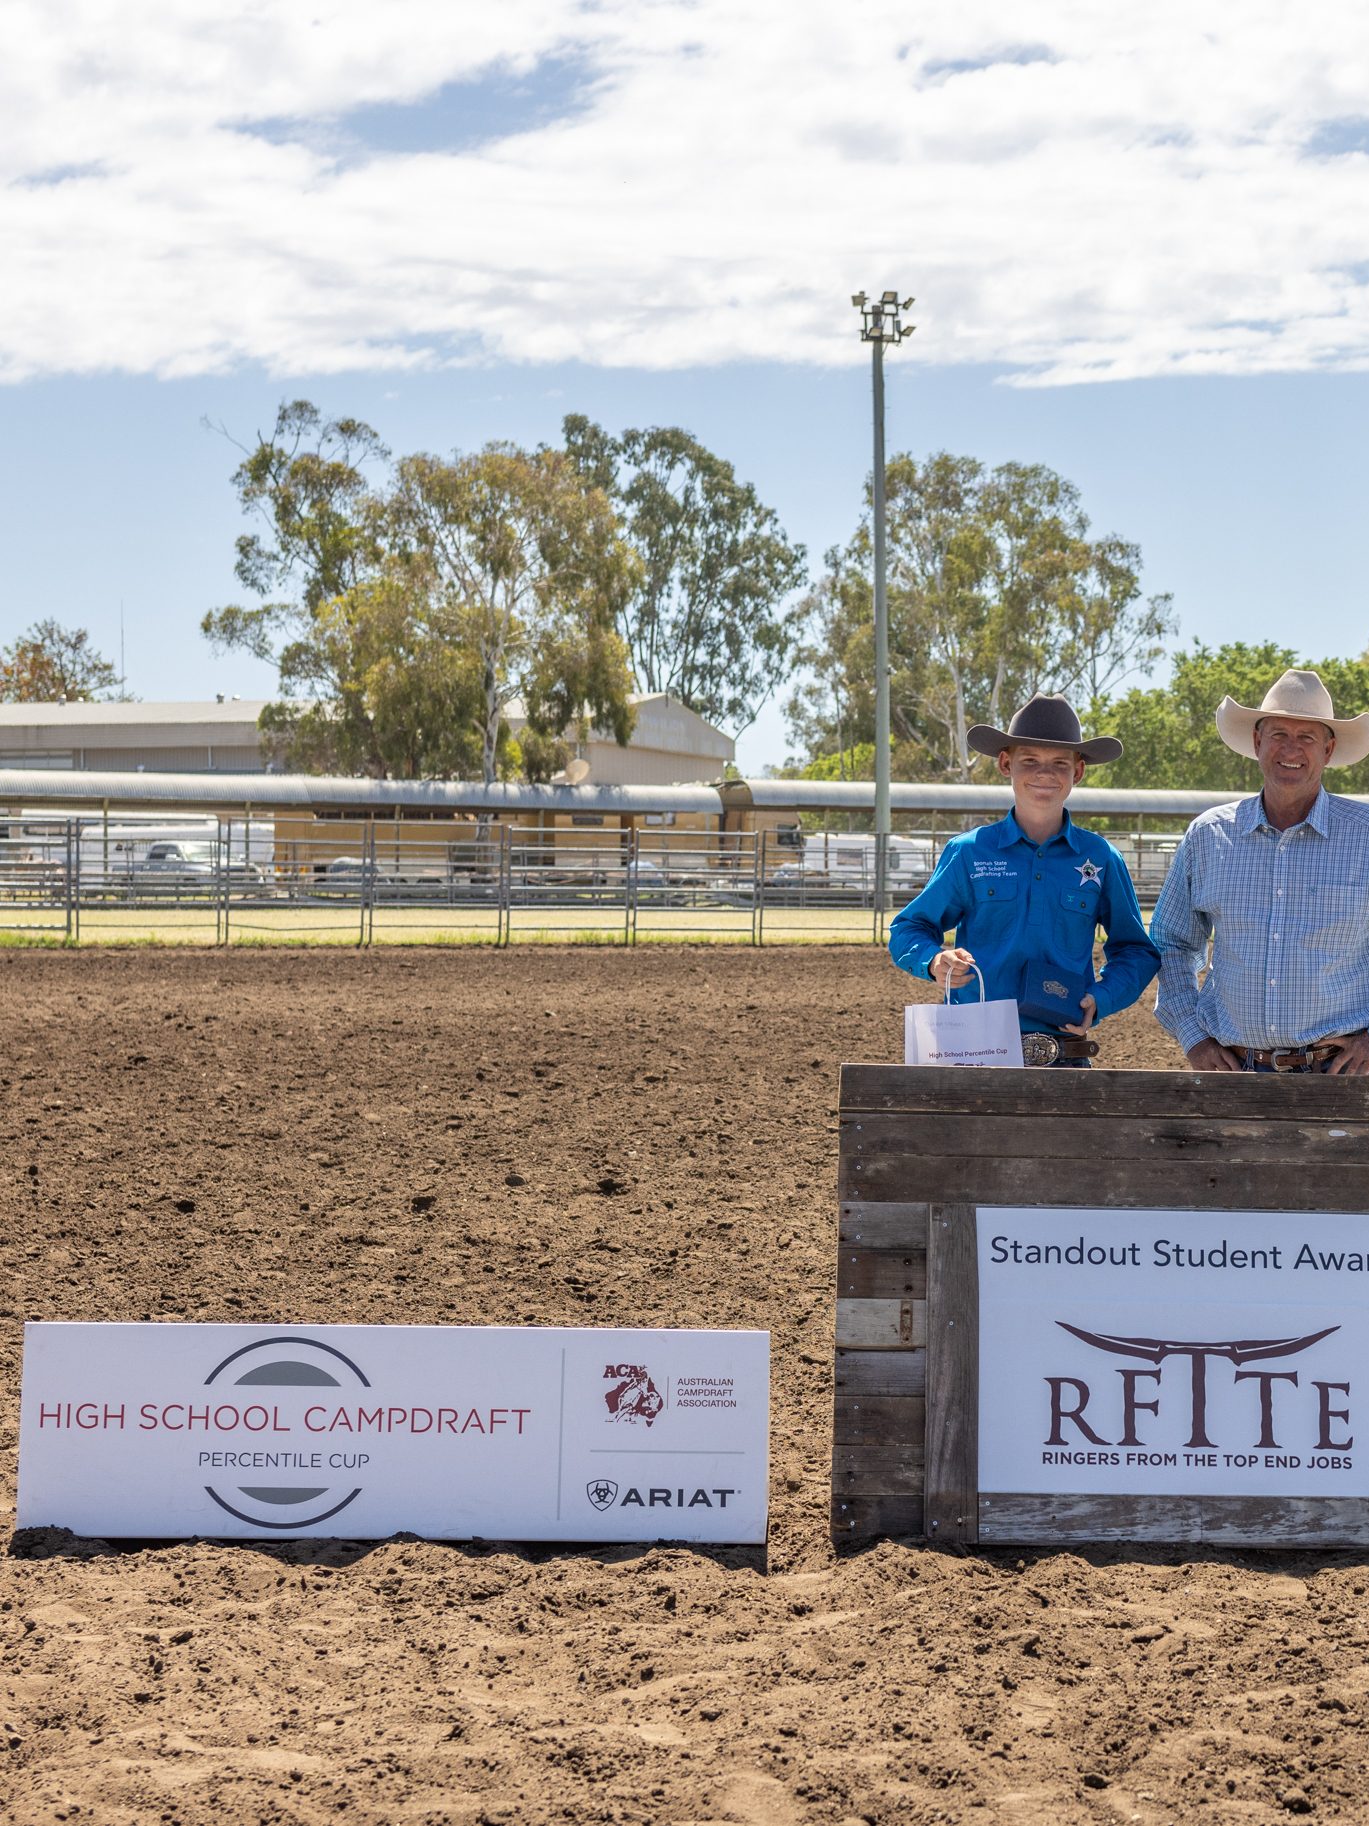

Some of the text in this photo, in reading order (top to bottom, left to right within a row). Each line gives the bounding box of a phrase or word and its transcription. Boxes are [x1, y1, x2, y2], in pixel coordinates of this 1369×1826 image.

[965, 1049, 995, 1057] Percentile
[996, 1047, 1008, 1055] Cup
[990, 1235, 1141, 1266] Standout
[1153, 1239, 1282, 1270] Student
[602, 1363, 641, 1379] ACA
[677, 1377, 734, 1386] AUSTRALIAN
[677, 1388, 734, 1397] CAMPDRAFT
[1042, 1344, 1354, 1452] RFTTE
[676, 1399, 737, 1408] ASSOCIATION
[39, 1402, 531, 1435] HIGH SCHOOL CAMPDRAFT
[198, 1451, 370, 1469] PERCENTILE CUP
[1042, 1451, 1353, 1470] RINGERS FROM THE TOP END JOBS
[619, 1487, 735, 1508] ARIAT
